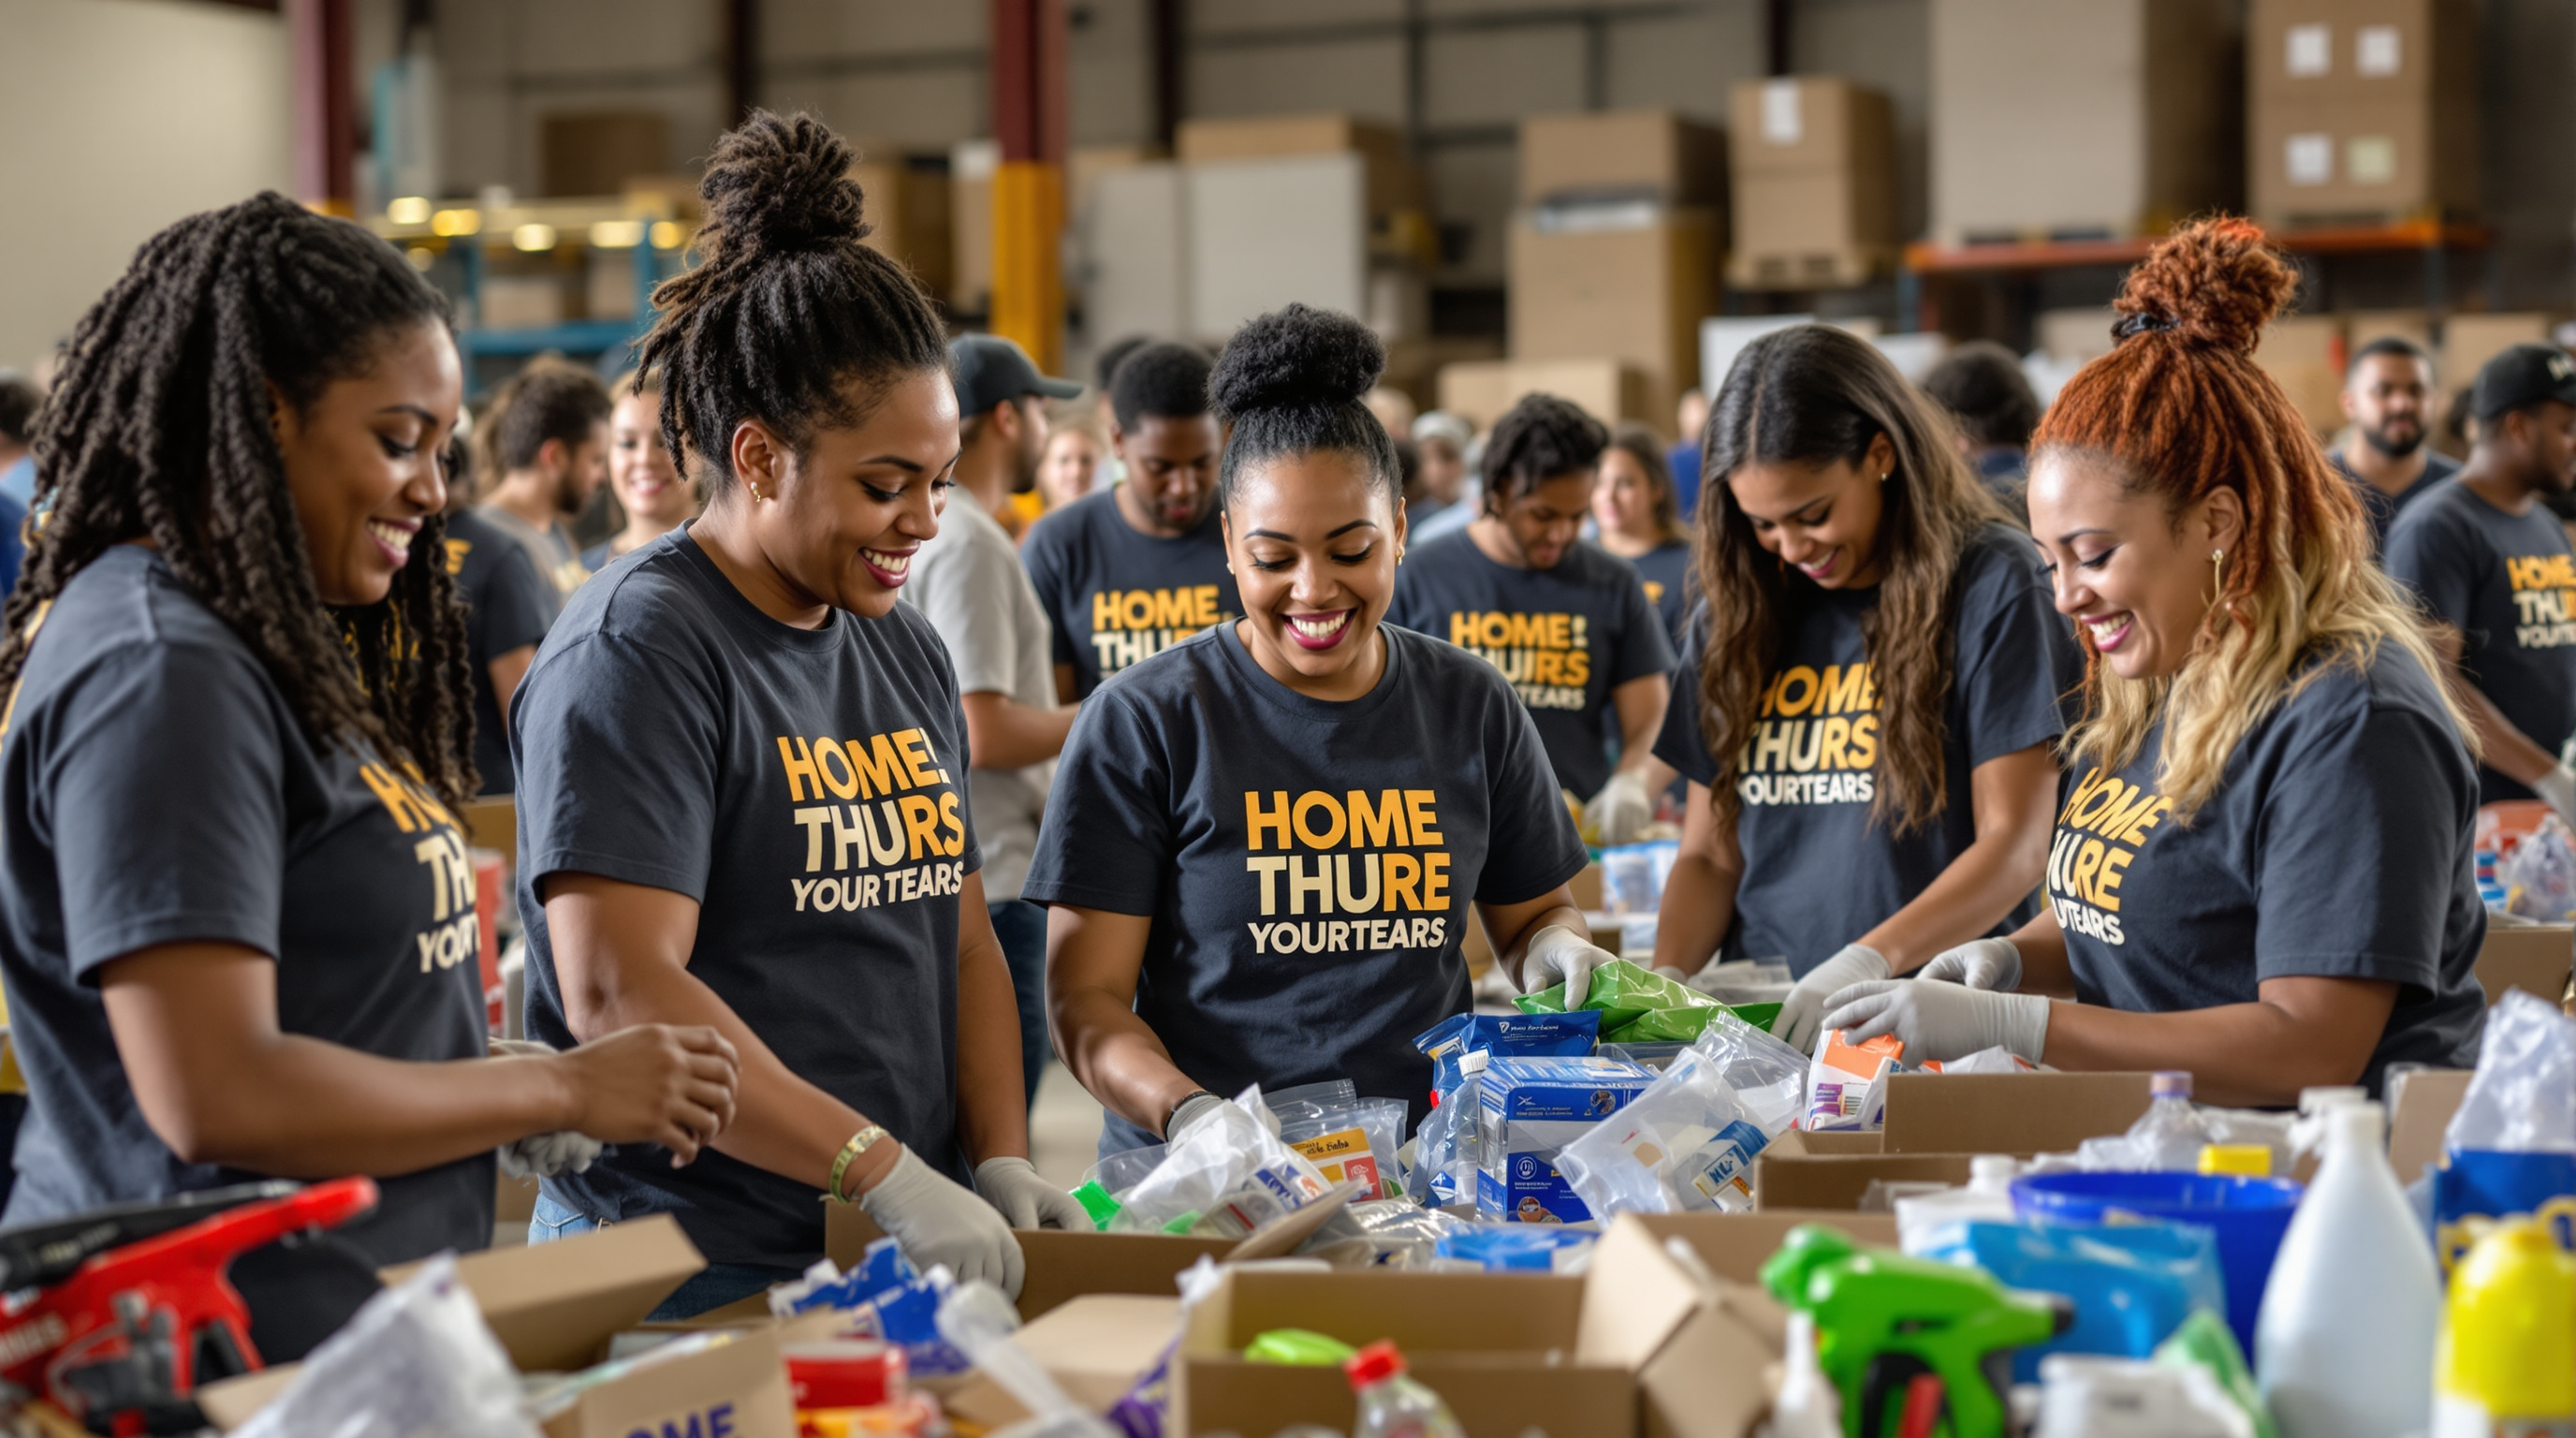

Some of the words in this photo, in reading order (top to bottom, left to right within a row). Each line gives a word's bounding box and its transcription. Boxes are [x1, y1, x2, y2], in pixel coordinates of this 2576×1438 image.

[777, 727, 951, 802] HOME!
[794, 791, 965, 873] THURS
[1244, 788, 1444, 851] HOME
[2057, 766, 2174, 848] HOME
[1246, 852, 1451, 916] THURE
